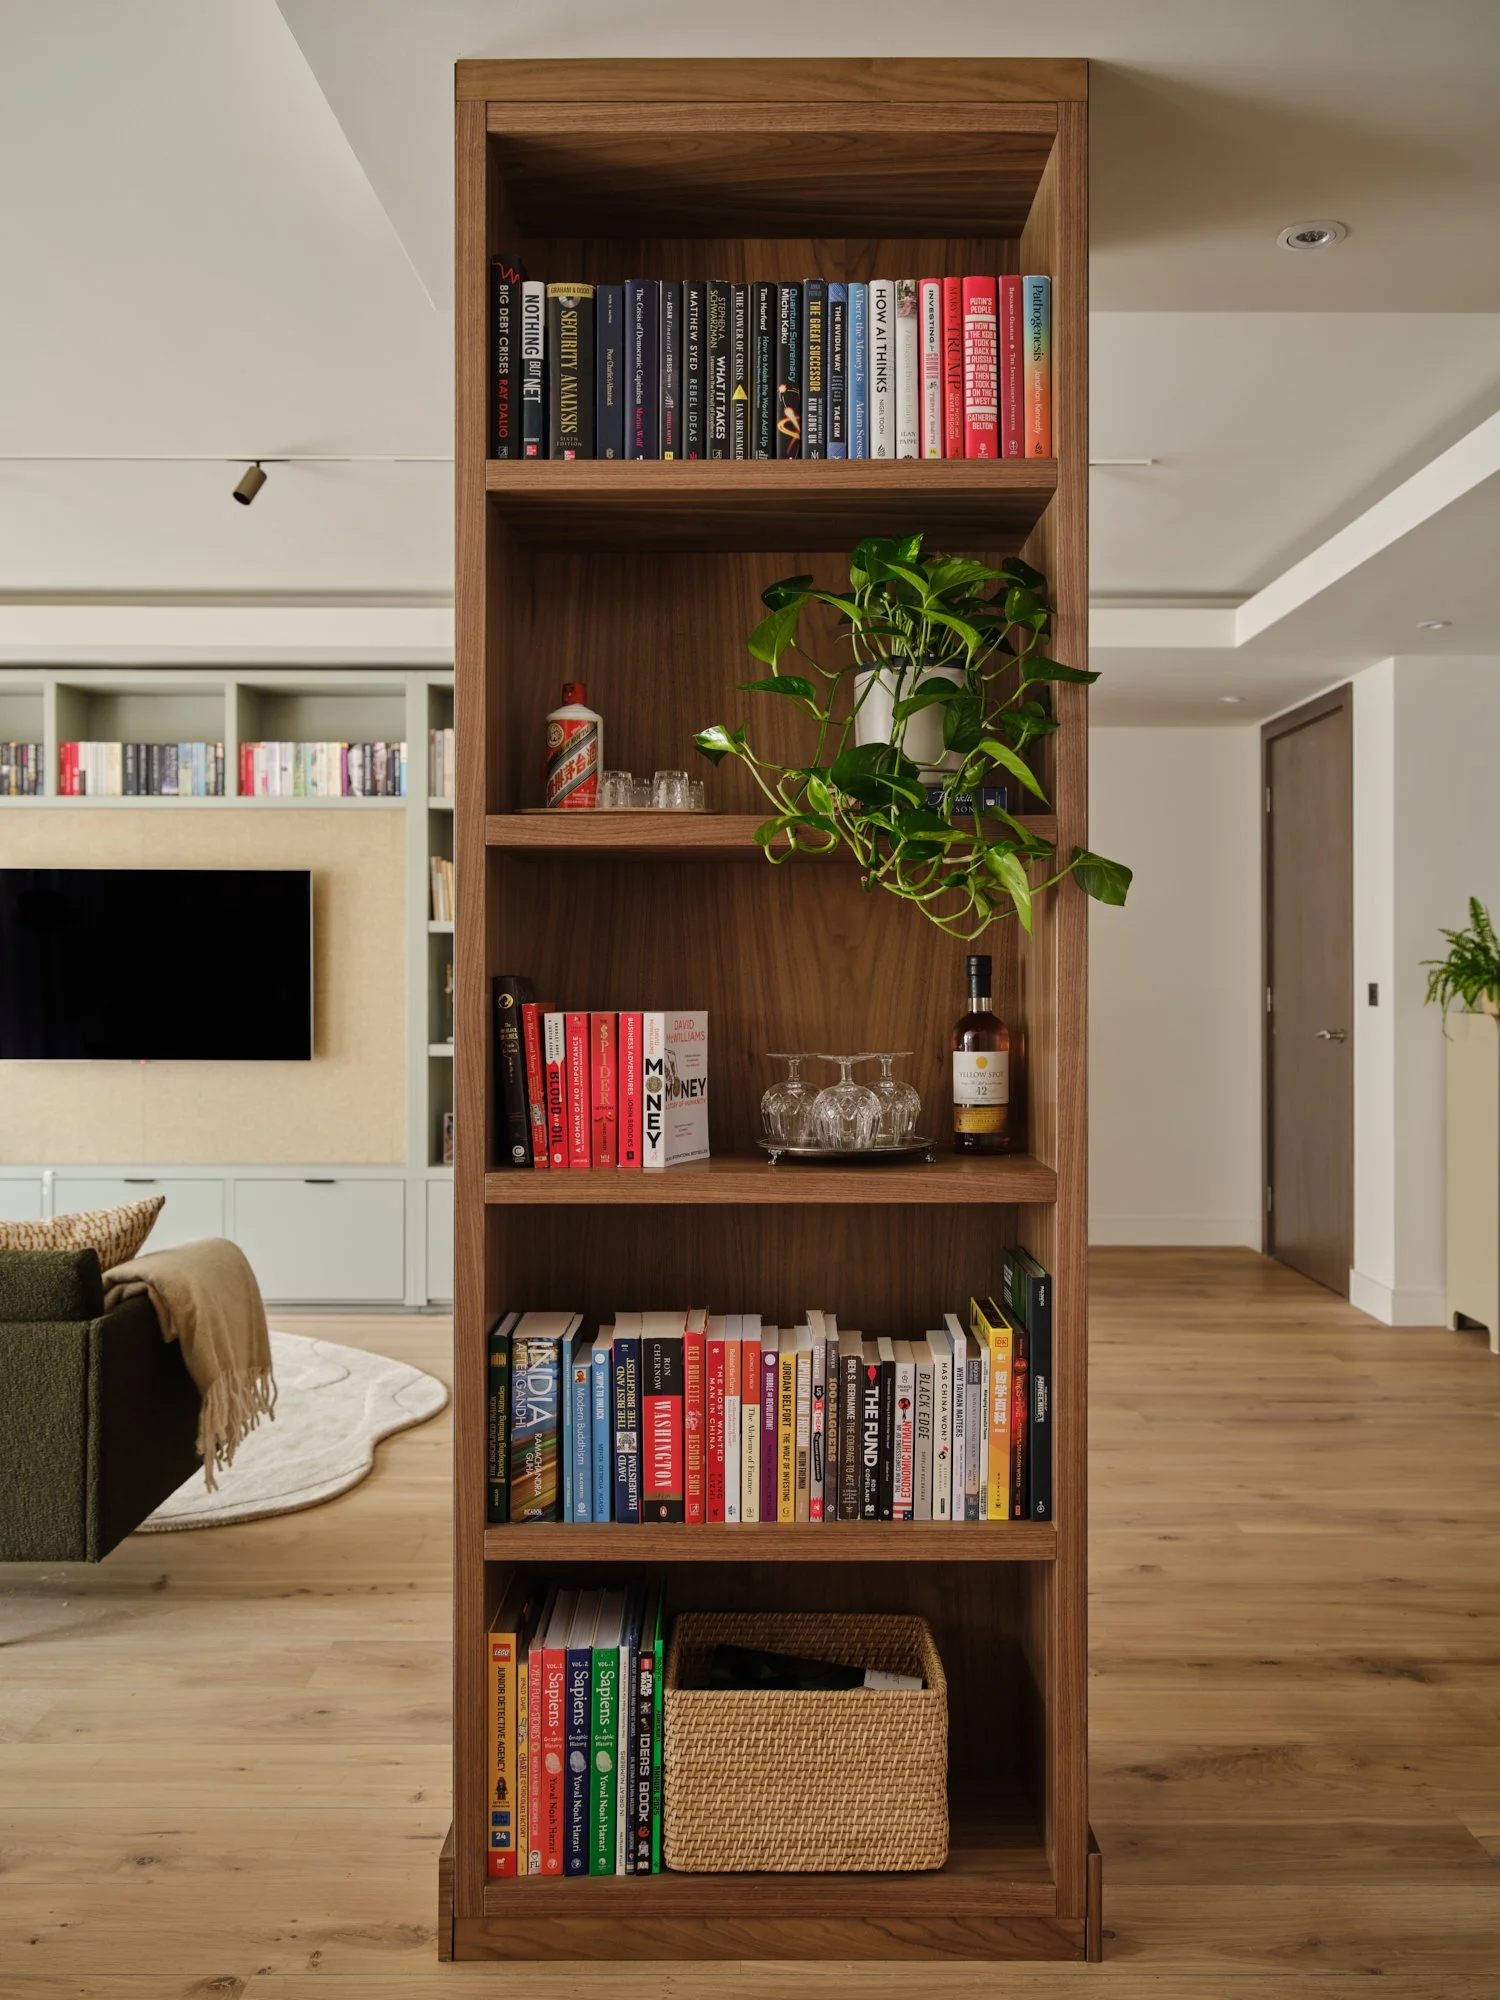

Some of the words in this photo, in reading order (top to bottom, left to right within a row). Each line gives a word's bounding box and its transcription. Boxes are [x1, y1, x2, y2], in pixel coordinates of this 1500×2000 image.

[499, 285, 509, 303] BIG
[736, 291, 744, 308] THE
[781, 289, 789, 318] Michio
[810, 301, 821, 315] THE
[876, 289, 887, 324] HOW
[499, 308, 509, 334] DEBT
[789, 289, 797, 330] Quantum
[1031, 285, 1044, 361] Pathogenesis
[525, 294, 540, 355] NOTHING
[636, 322, 643, 330] of
[736, 310, 744, 341] POWER
[781, 320, 789, 343] Kaku
[810, 318, 821, 342] GREAT
[876, 327, 887, 340] AI
[561, 310, 578, 370] SECURITY
[736, 342, 744, 353] OF
[499, 337, 509, 374] CRISES
[529, 361, 541, 376] BUT
[736, 354, 744, 380] CRISIS
[788, 332, 797, 382] Supremacy
[810, 345, 821, 392] SUCCESSOR
[876, 344, 887, 393] THINKS
[634, 370, 643, 404] Capitalism
[716, 356, 725, 390] WHAT
[499, 379, 508, 399] RAY
[523, 378, 541, 403] NET
[689, 379, 697, 407] REBEL
[716, 392, 725, 402] IT
[561, 374, 578, 433] ANALYSIS
[736, 403, 744, 418] IAN
[498, 403, 509, 438] DALIO
[689, 412, 697, 441] IDEAS
[716, 404, 725, 439] TAKES
[1033, 404, 1041, 434] Kennedy
[760, 436, 768, 447] Up
[666, 1031, 706, 1043] McWILLIAMS
[674, 1019, 694, 1030] DAVID
[988, 1071, 1004, 1079] SPOT
[574, 1088, 579, 1099] NO
[645, 1058, 663, 1149] MONEY
[665, 1077, 706, 1102] MONEY
[977, 1086, 987, 1096] 12
[574, 1103, 580, 1112] OF
[515, 1343, 526, 1377] AFTER
[847, 1359, 856, 1373] BEN
[956, 1367, 964, 1381] WHY
[527, 1341, 552, 1427] INDIA
[617, 1366, 625, 1386] AND
[627, 1358, 636, 1407] BRIGHTEST
[782, 1361, 791, 1392] JORDAN
[919, 1373, 930, 1407] BLACK
[515, 1380, 526, 1428] GANDHI
[577, 1388, 585, 1421] Modern
[617, 1390, 625, 1408] BEST
[847, 1383, 856, 1420] BERNANKE
[865, 1386, 879, 1419] THE
[956, 1383, 964, 1408] TAIWAN
[1035, 1375, 1045, 1422] MINECRAFT
[618, 1410, 626, 1429] THE
[628, 1410, 636, 1429] THE
[747, 1408, 756, 1422] The
[782, 1395, 791, 1427] BELFORT
[955, 1409, 964, 1437] MATTERS
[746, 1424, 756, 1454] Alchemy
[846, 1422, 855, 1433] THE
[902, 1421, 912, 1453] HITMAN
[918, 1412, 930, 1440] EDGE
[577, 1423, 585, 1465] Buddhism
[654, 1401, 672, 1487] WASHINGTON
[846, 1435, 855, 1463] COURAGE
[864, 1422, 878, 1467] FUND
[525, 1453, 533, 1476] GUHA
[534, 1433, 542, 1496] RAMACHANDRA
[618, 1455, 627, 1482] DAVID
[783, 1462, 790, 1470] OF
[846, 1465, 855, 1473] TO
[901, 1456, 911, 1498] ECONOMIC
[629, 1455, 638, 1510] HALBERSTAM
[747, 1465, 755, 1495] Finance
[846, 1475, 855, 1486] ACT
[497, 1665, 506, 1694] JUNIOR
[545, 1672, 563, 1727] Sapiens
[570, 1671, 589, 1725] Sapiens
[597, 1670, 618, 1725] Sapiens
[497, 1696, 506, 1739] DETECTIVE
[497, 1741, 506, 1772] AGENCY
[639, 1733, 650, 1776] IDEAS
[548, 1777, 558, 1800] Yuval
[572, 1774, 583, 1798] Yuval
[598, 1774, 609, 1798] Yuval
[548, 1802, 558, 1824] Noah
[572, 1800, 583, 1822] Noah
[598, 1800, 609, 1822] Noah
[638, 1782, 650, 1821] BOOK
[495, 1833, 507, 1841] 24
[548, 1827, 558, 1854] Harari
[572, 1825, 583, 1852] Harari
[598, 1825, 609, 1852] Harari
